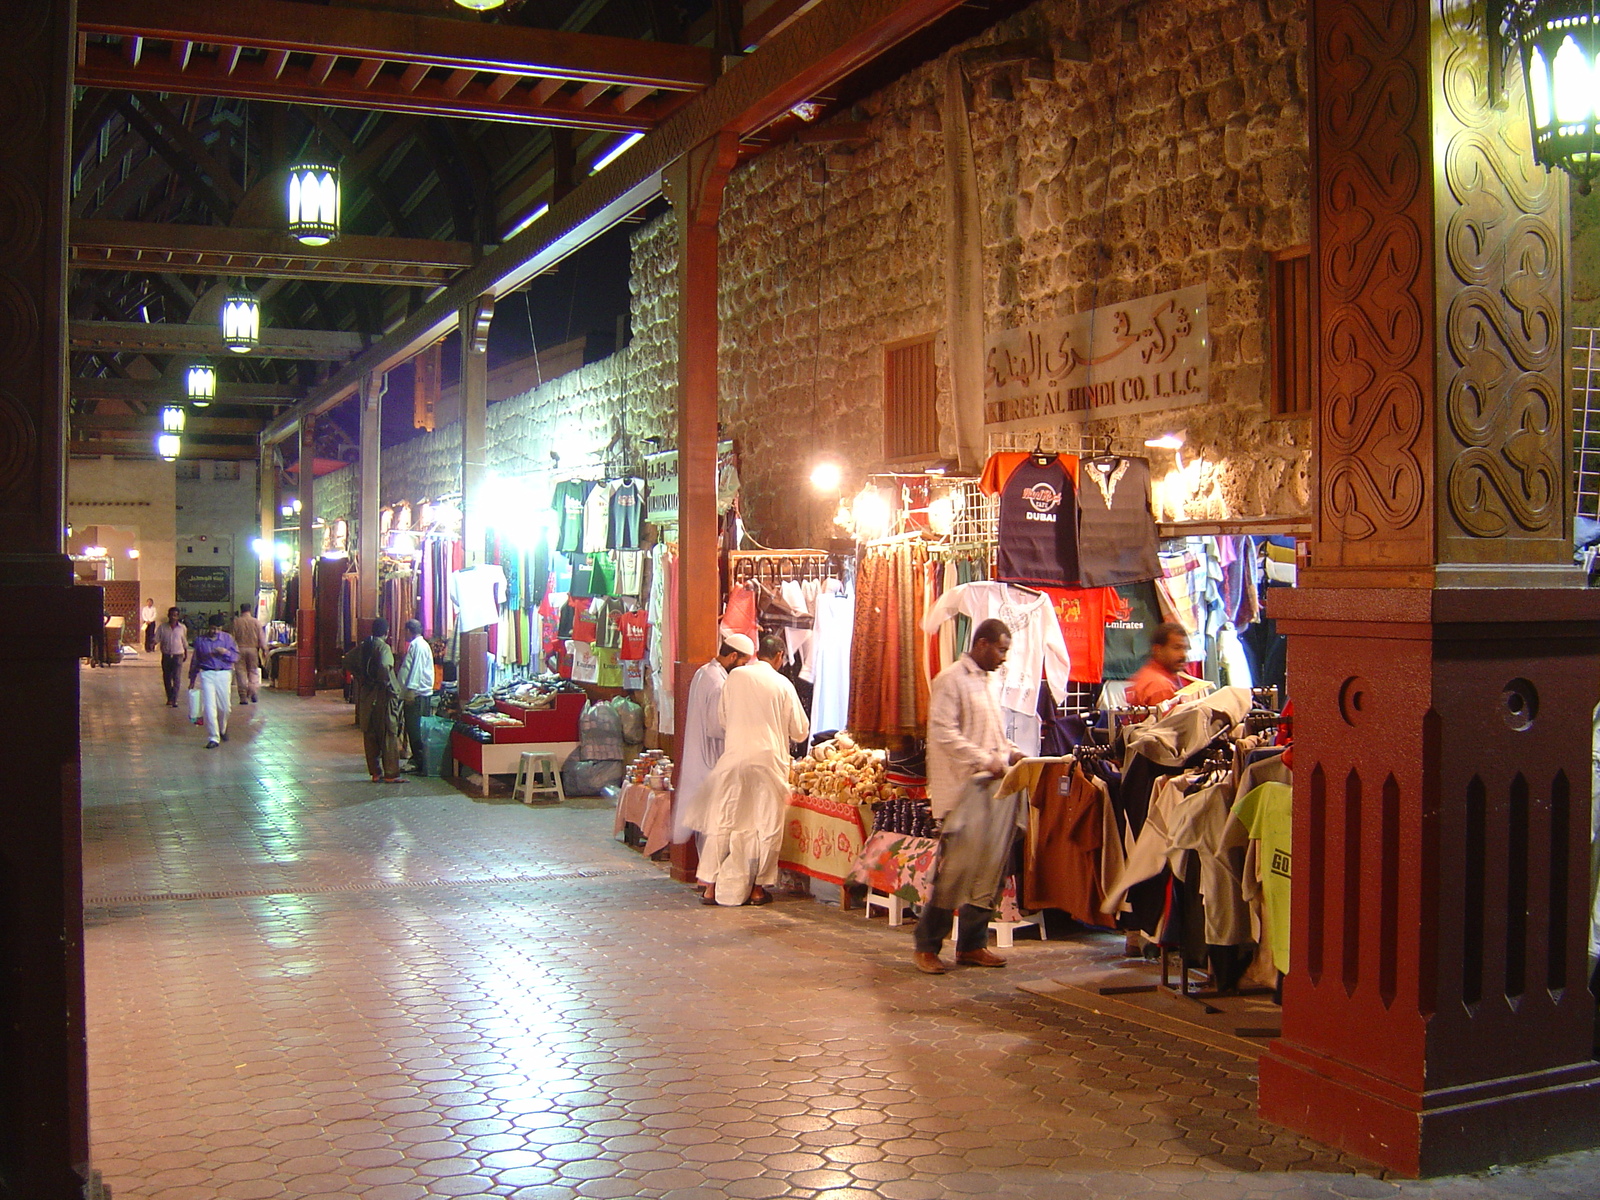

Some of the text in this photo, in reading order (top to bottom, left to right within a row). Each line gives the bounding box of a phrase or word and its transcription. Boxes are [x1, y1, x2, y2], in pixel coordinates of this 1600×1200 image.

[1141, 299, 1193, 364] شركة
[985, 395, 1039, 425] KHREE
[1044, 393, 1065, 416] AL
[1067, 381, 1116, 412] HINDI
[1121, 376, 1150, 403] CO.
[1026, 511, 1057, 522] DUBAI
[1105, 620, 1144, 630] Emirates
